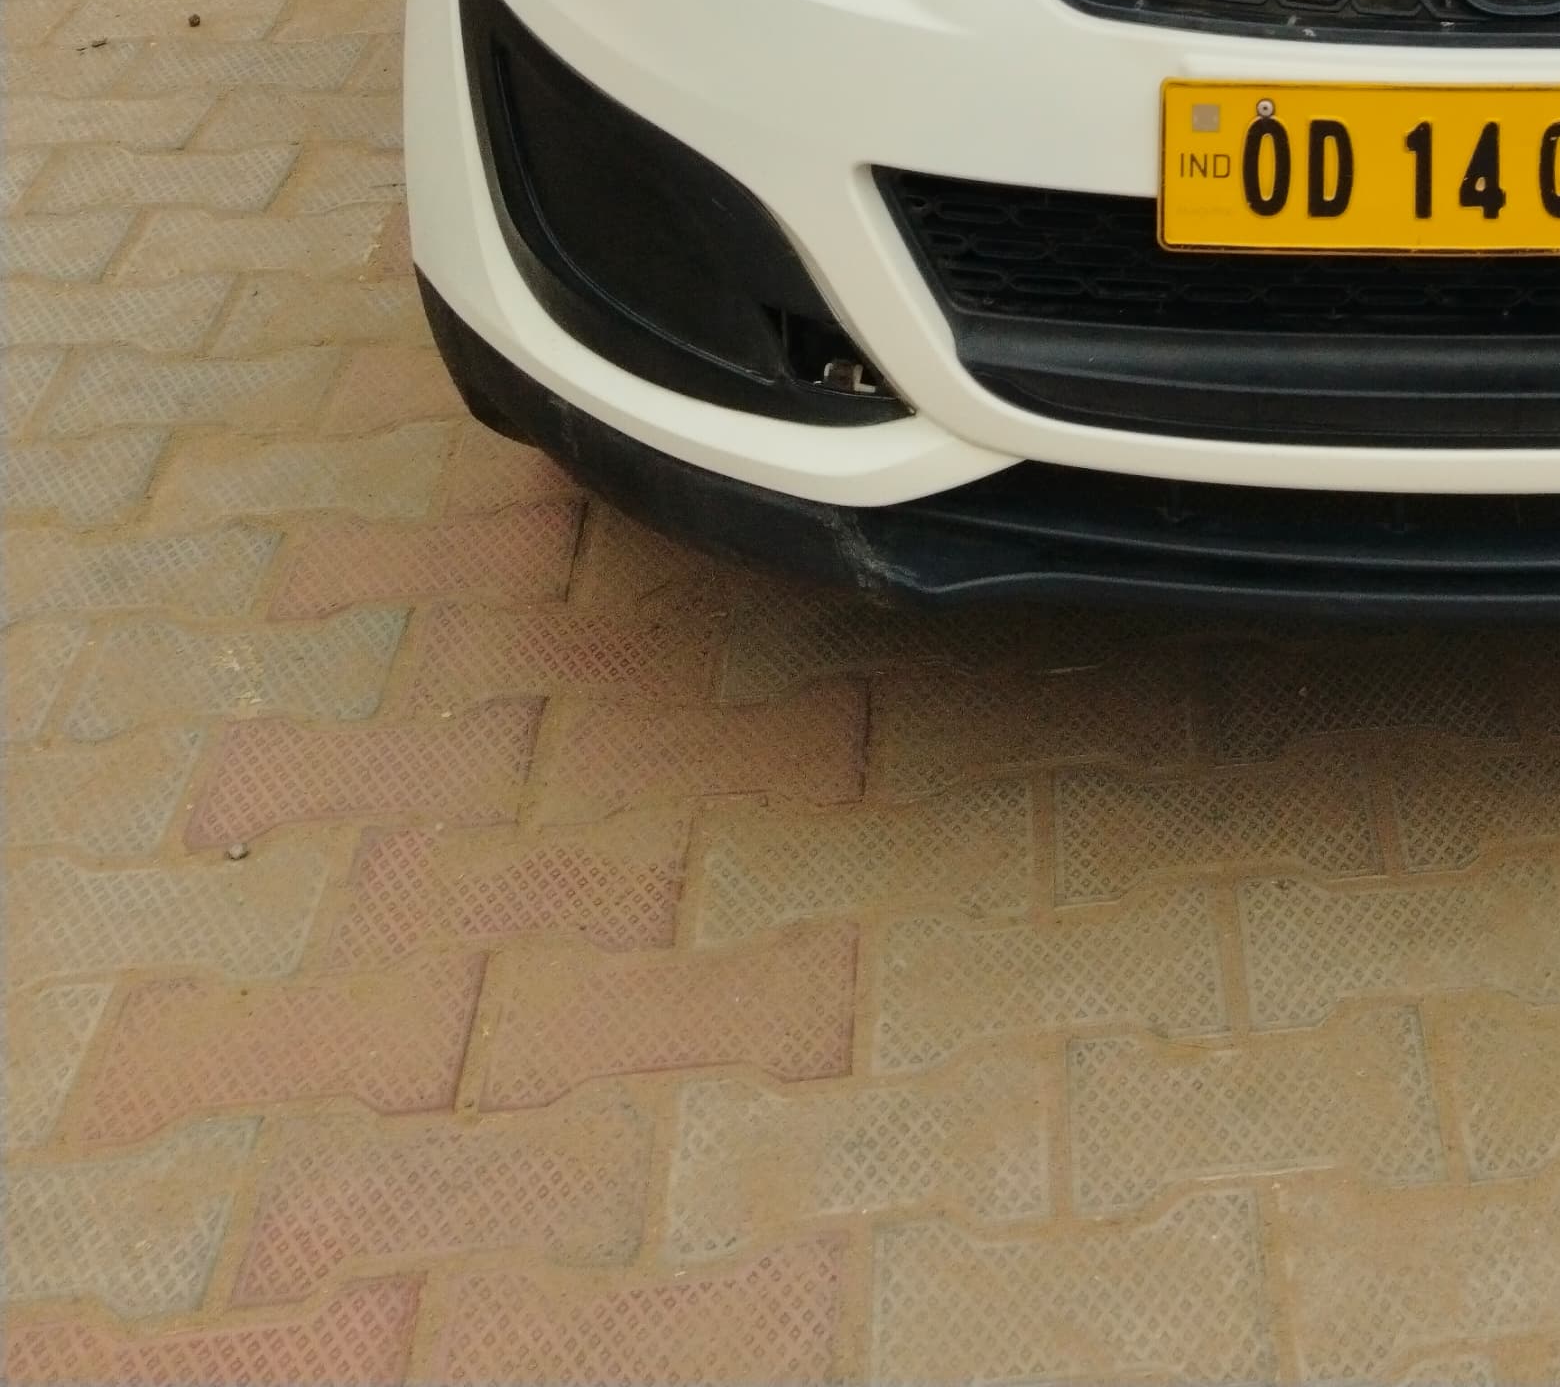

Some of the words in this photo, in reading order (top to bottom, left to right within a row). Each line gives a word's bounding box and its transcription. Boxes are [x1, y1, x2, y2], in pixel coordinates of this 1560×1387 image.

[1180, 153, 1231, 178] IND
[1242, 117, 1354, 217] OD
[1406, 120, 1506, 219] 14
